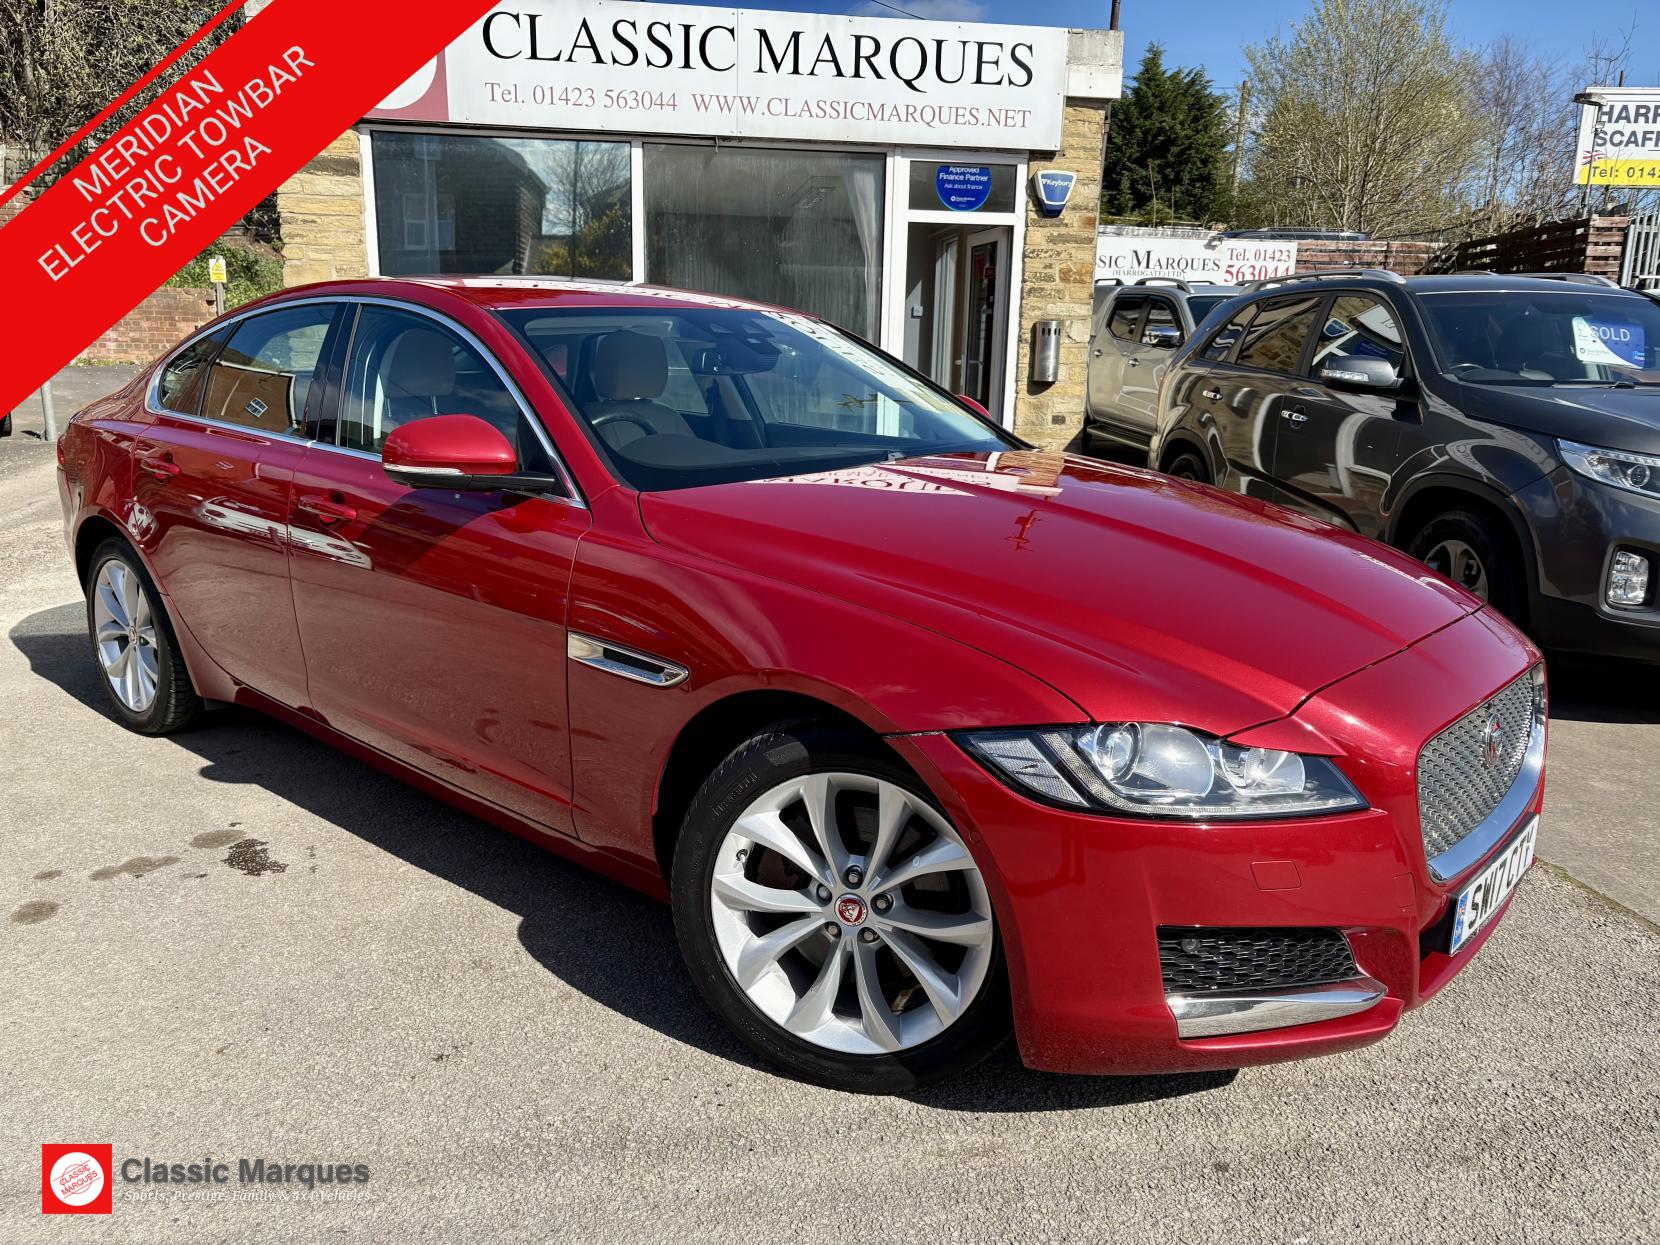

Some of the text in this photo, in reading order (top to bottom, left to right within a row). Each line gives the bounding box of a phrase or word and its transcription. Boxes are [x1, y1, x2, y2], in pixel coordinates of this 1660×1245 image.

[482, 11, 1034, 93] CLASSIC MARQUES
[484, 82, 1032, 128] Tel. 01423 563044 WWW.CLASSICMARQUES.NET
[965, 174, 989, 182] Partner
[1592, 166, 1660, 178] Tel: 014
[1130, 249, 1221, 274] MARQUES
[1227, 248, 1291, 262] Tel. 01423
[1224, 264, 1291, 283] 563044
[1590, 326, 1631, 341] SOLD
